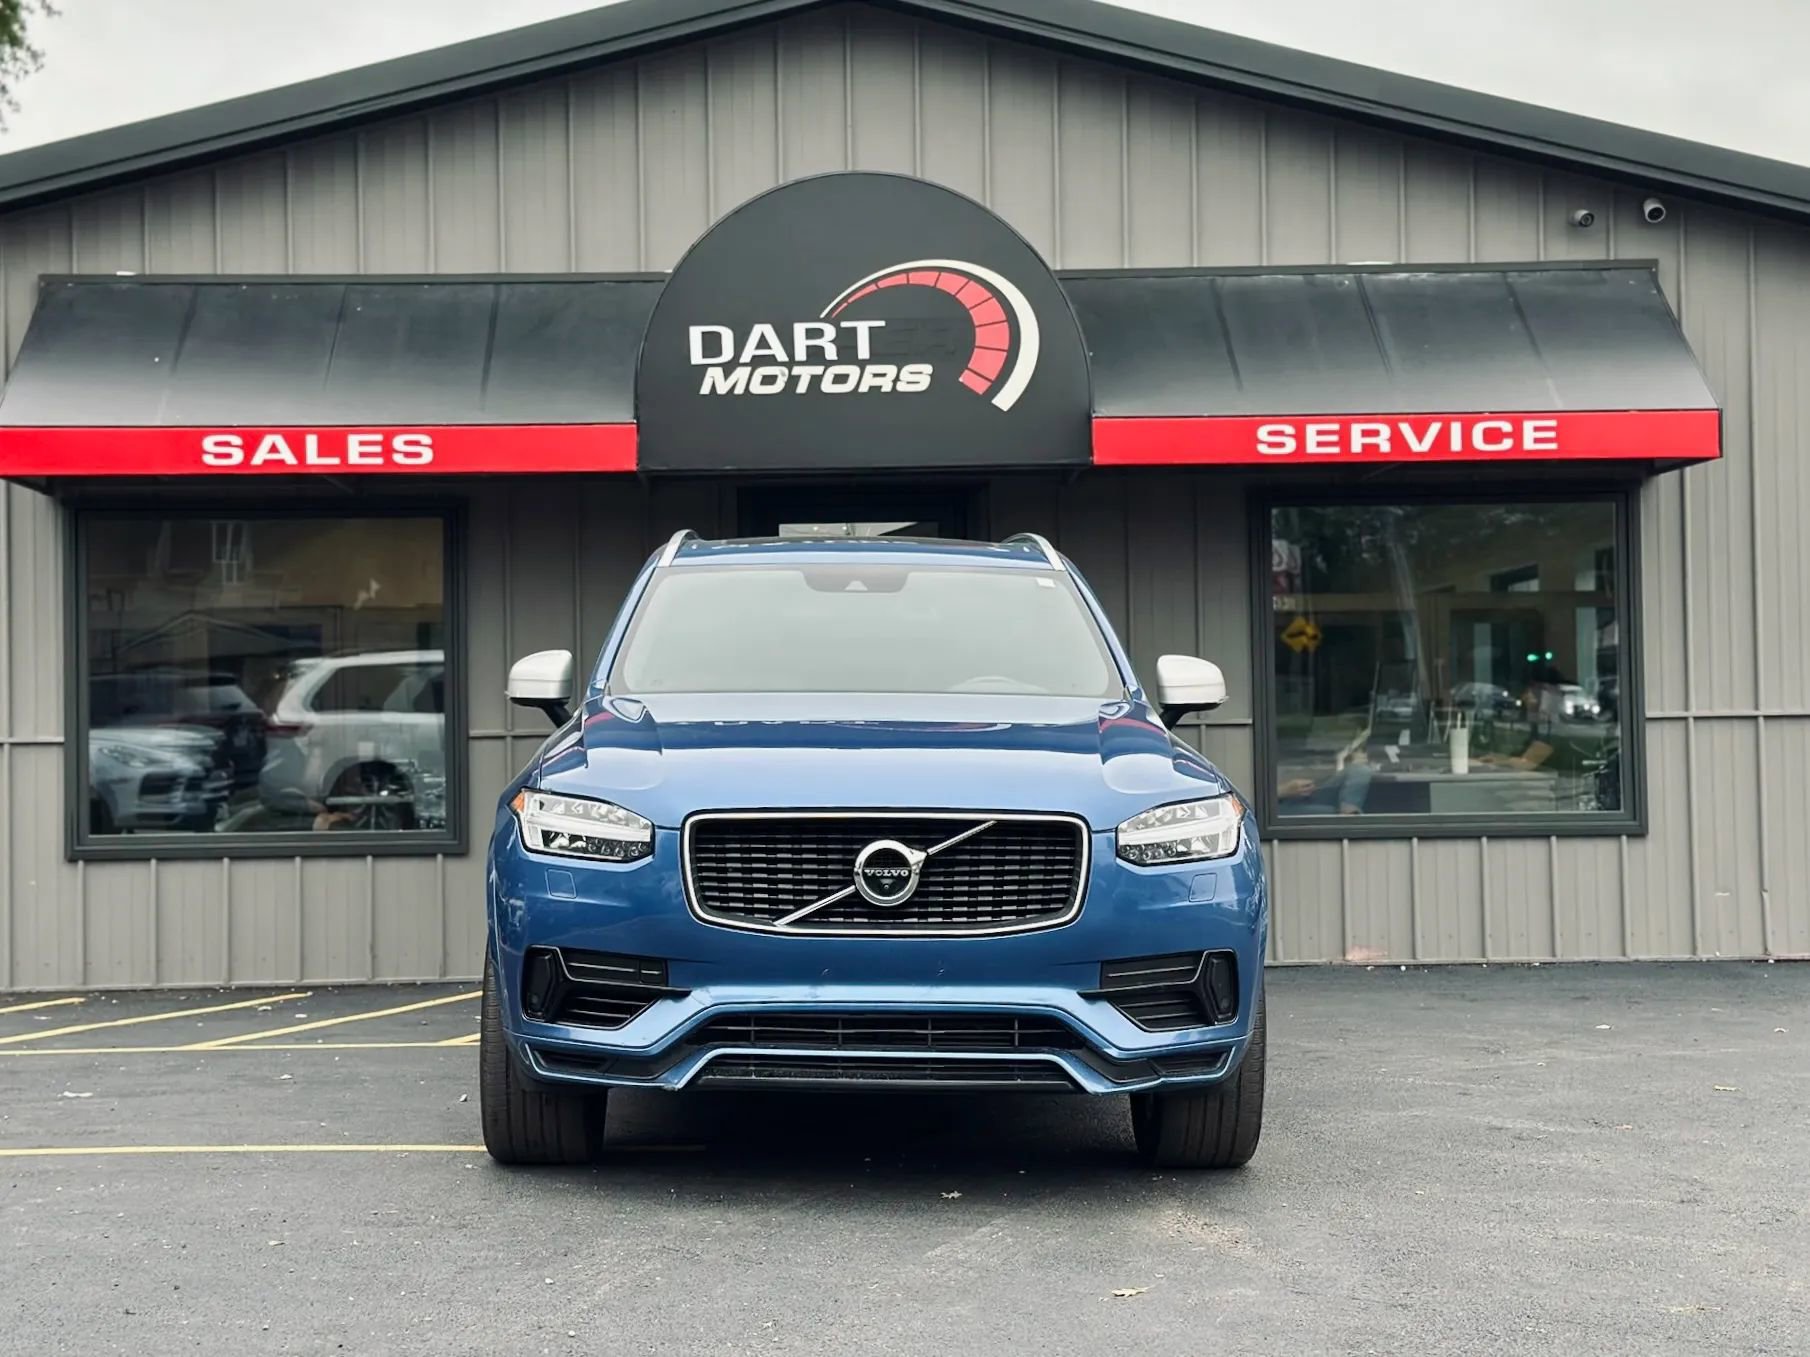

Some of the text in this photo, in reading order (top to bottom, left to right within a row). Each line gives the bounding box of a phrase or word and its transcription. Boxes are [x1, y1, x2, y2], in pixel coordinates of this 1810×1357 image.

[688, 320, 886, 365] DART
[699, 363, 933, 395] MOTORS
[201, 434, 434, 466] SALES
[1256, 420, 1558, 455] SERVICE
[864, 869, 909, 877] VOLVO
